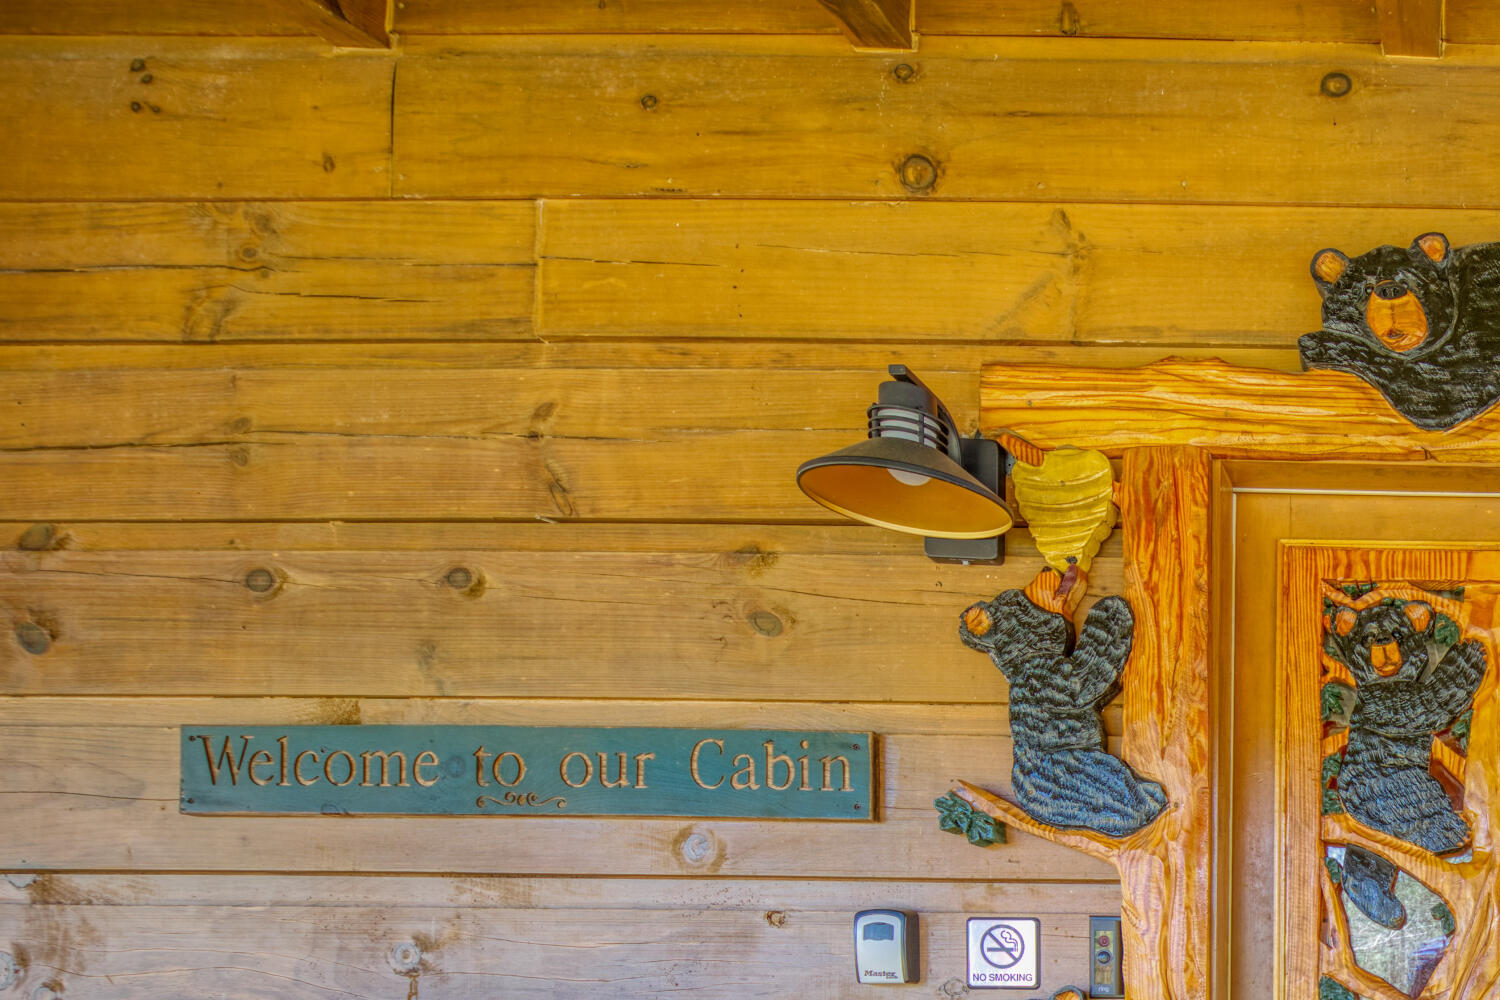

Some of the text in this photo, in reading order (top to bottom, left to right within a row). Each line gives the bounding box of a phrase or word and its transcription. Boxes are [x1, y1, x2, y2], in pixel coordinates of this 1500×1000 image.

[201, 734, 854, 793] Welcome to our Cabin
[972, 973, 1033, 982] NO SMOKING
